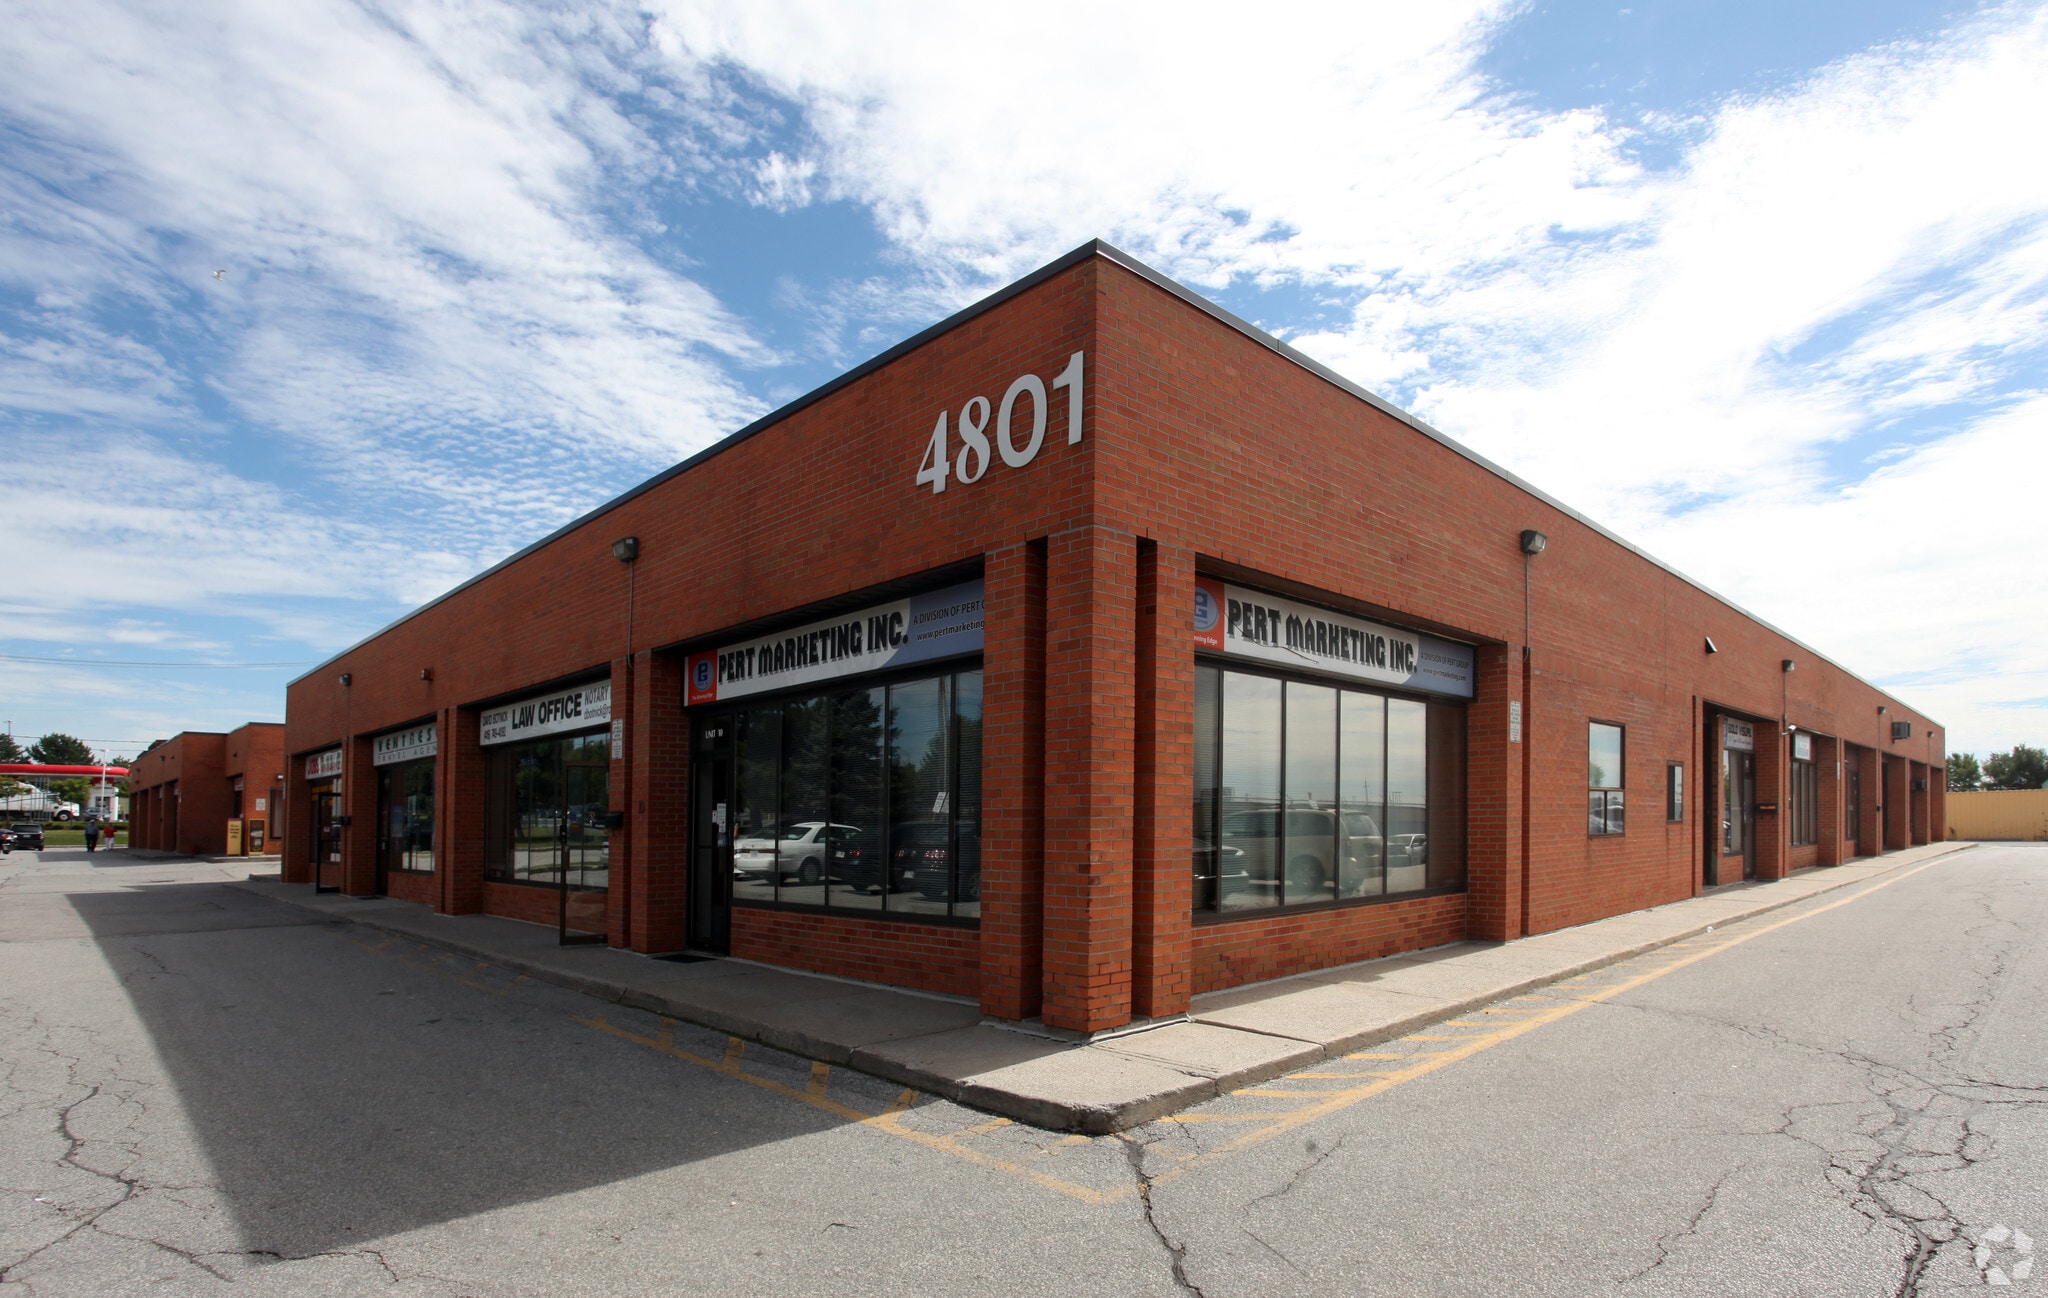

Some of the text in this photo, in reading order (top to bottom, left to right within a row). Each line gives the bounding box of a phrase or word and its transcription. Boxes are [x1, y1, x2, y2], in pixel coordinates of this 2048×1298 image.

[916, 350, 1084, 495] 4801
[913, 615, 919, 625] A
[919, 607, 949, 624] DIVISION
[950, 604, 960, 617] OF
[961, 600, 979, 614] PERT
[718, 611, 909, 686] PERT MARKETING INC.
[1227, 598, 1418, 674] PERT MARKETING INC.
[512, 692, 582, 730] LAW OFFICE
[584, 684, 609, 706] NOTARY
[378, 751, 406, 763] TRAVEL
